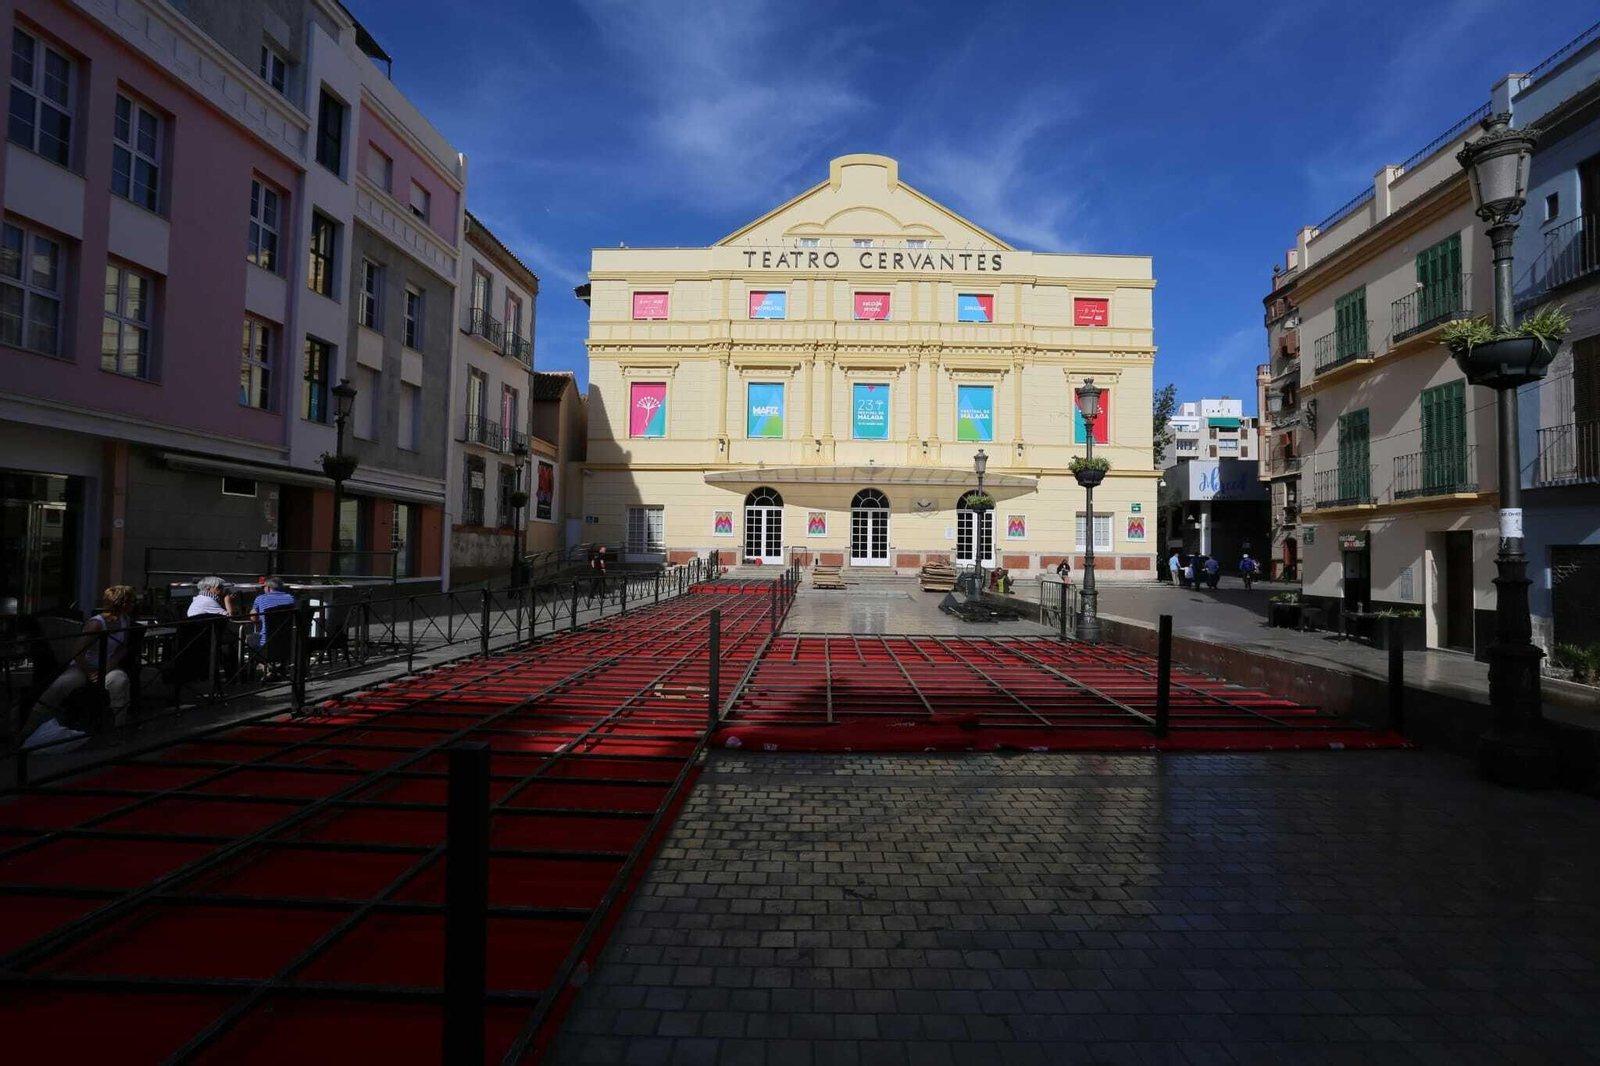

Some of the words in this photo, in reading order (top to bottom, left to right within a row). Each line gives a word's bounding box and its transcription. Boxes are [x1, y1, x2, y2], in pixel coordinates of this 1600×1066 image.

[743, 251, 840, 269] TEATRO
[859, 252, 1002, 271] CERVANTES
[857, 399, 874, 411] 23
